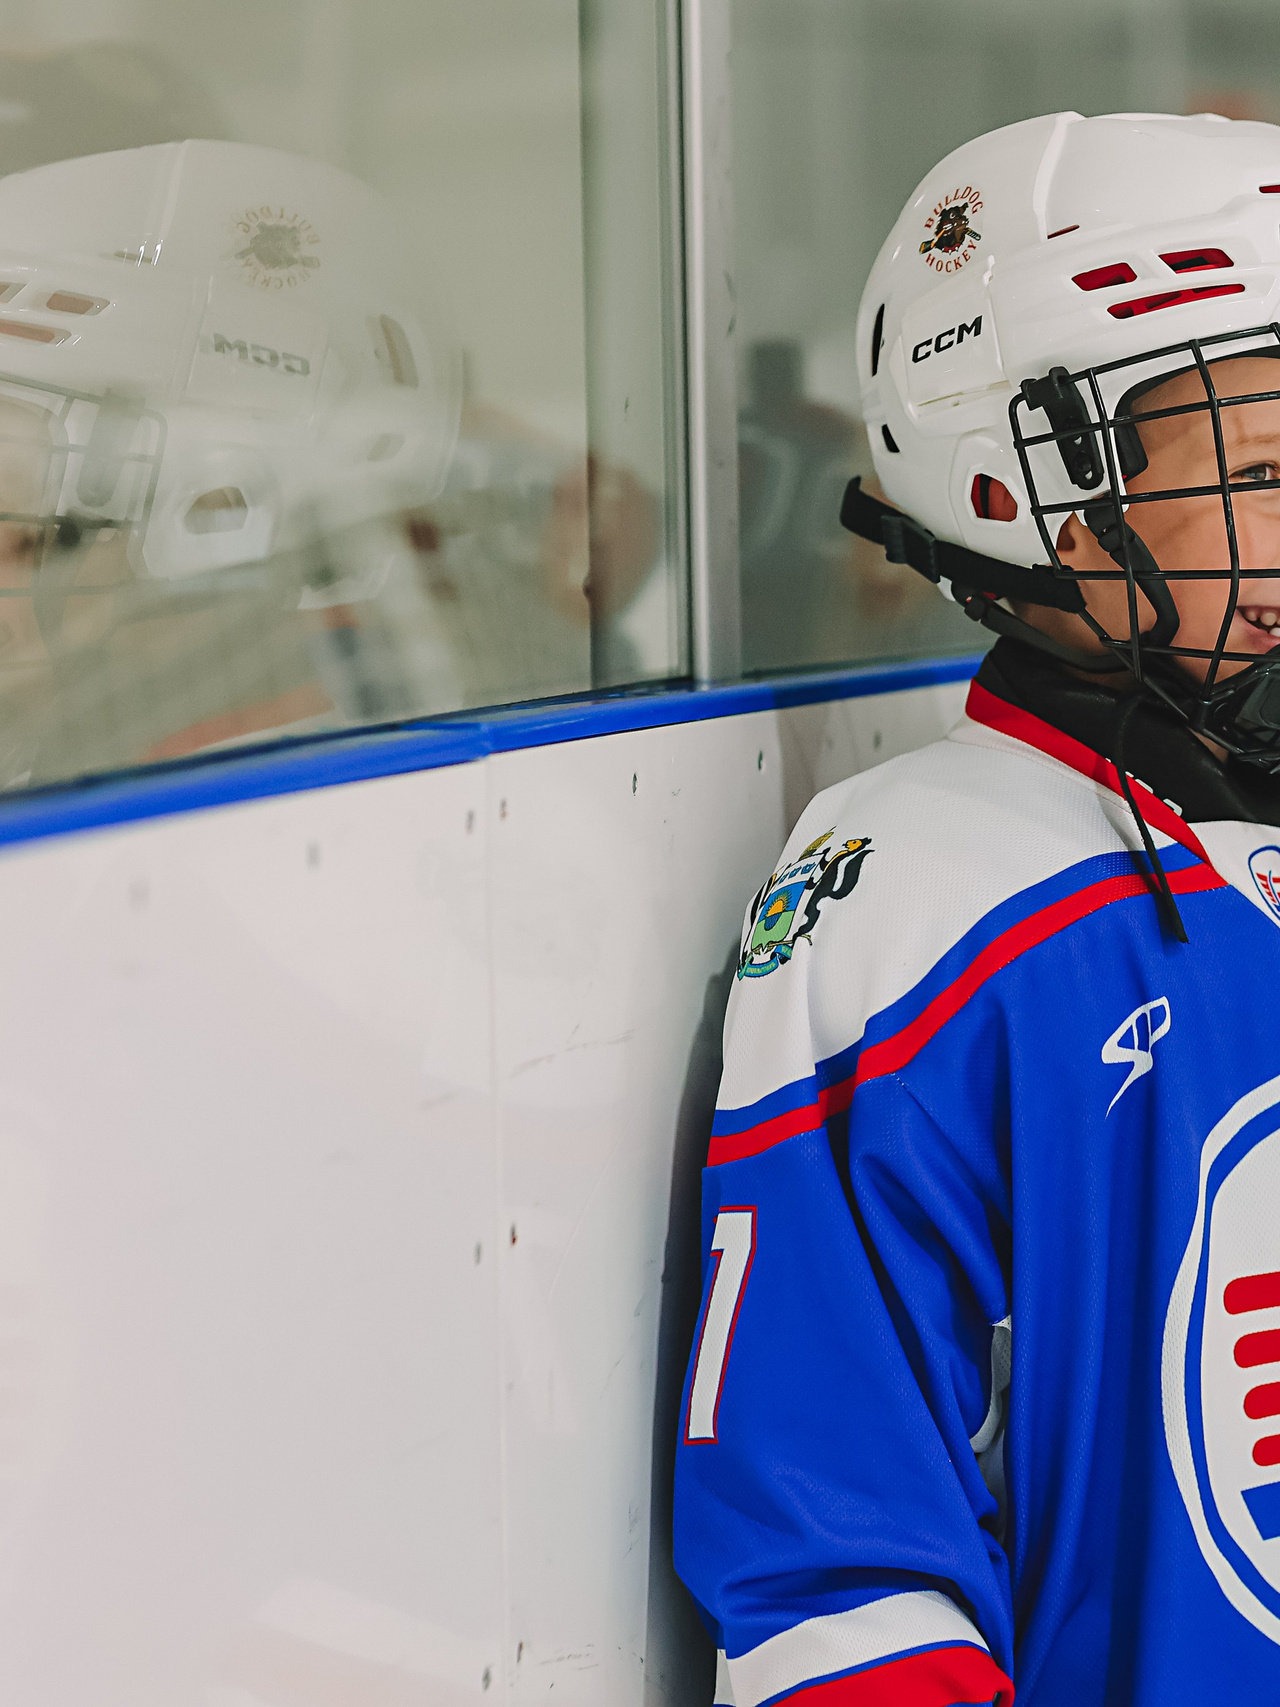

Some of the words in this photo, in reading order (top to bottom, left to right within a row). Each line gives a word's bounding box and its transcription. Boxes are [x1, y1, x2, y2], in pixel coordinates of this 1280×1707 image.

[924, 186, 984, 229] BULLDOG
[925, 239, 978, 273] HOCKEY
[911, 315, 983, 364] CCM
[685, 1205, 757, 1445] 1
